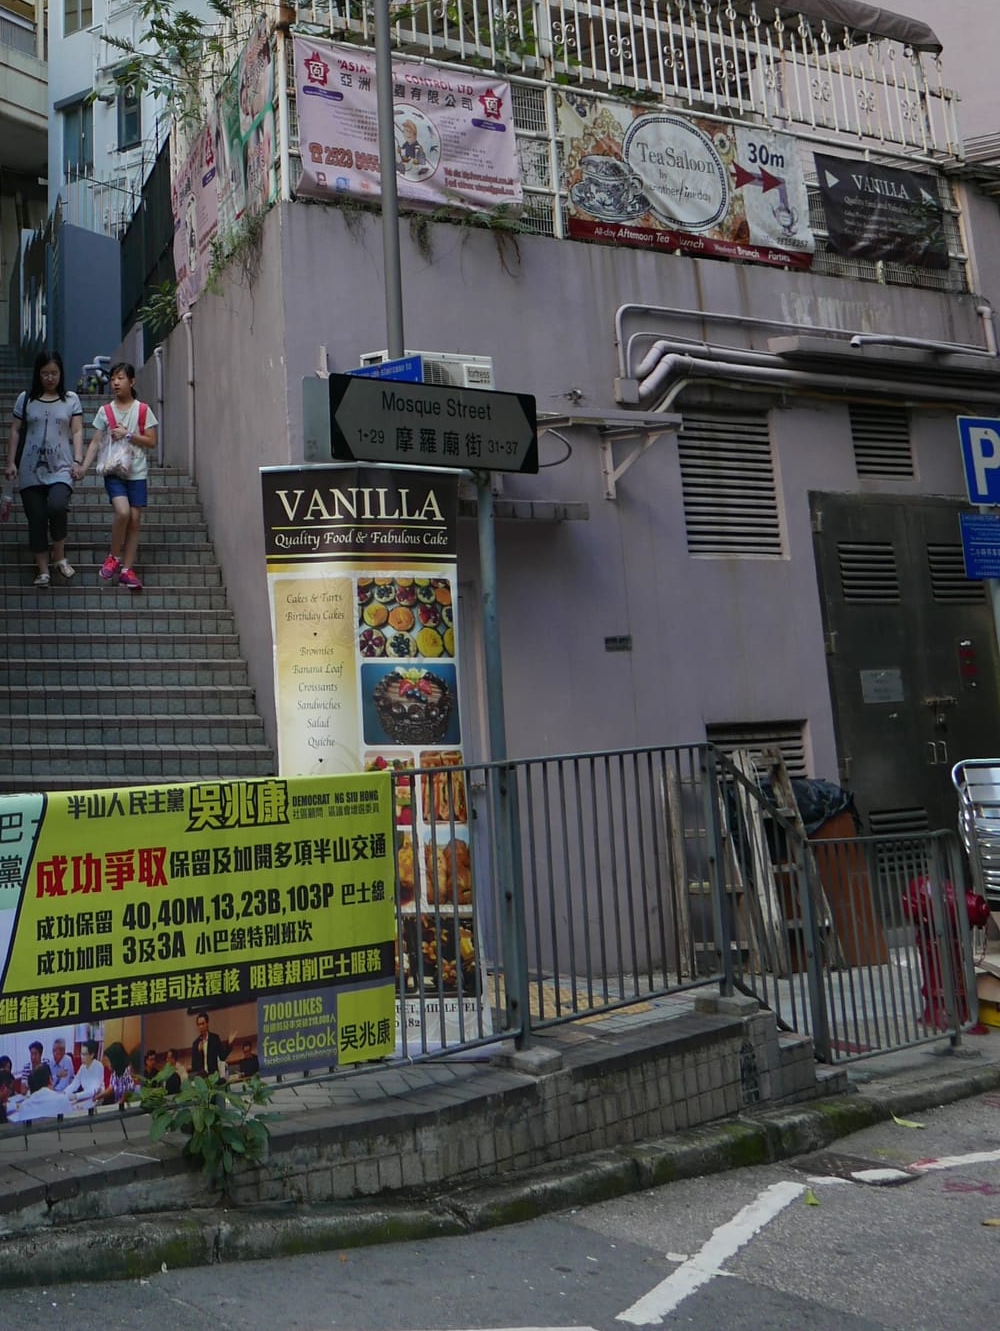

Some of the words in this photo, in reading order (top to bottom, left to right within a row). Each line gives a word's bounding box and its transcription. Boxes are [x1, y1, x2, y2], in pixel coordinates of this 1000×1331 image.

[339, 72, 474, 112] 亞洲蟲有限公司
[405, 74, 453, 92] CONTROL
[747, 142, 785, 168] 30m
[851, 174, 911, 200] VANILLA
[617, 227, 654, 243] Afternoon
[656, 232, 670, 244] Tea
[736, 245, 760, 260] Brunch
[768, 249, 791, 263] Parties
[381, 390, 441, 418] Mosque
[446, 397, 493, 421] Street
[395, 426, 482, 459] 摩羅廟街
[968, 426, 1000, 496] P
[275, 487, 446, 522] VANILLA
[274, 531, 321, 551] Quality
[323, 528, 354, 545] Food
[355, 531, 369, 545] &
[370, 529, 421, 545] Fabulous
[422, 531, 449, 546] Cake
[286, 593, 309, 604] Cakes
[311, 593, 321, 604] &
[320, 593, 343, 603] Tarts
[285, 611, 322, 623] Birthday
[322, 610, 345, 621] Cakes
[299, 646, 335, 657] Brownies
[291, 664, 323, 675] Banana
[324, 662, 345, 678] Loaf
[298, 682, 338, 693] Croissants
[296, 700, 342, 711] Sandwiches
[306, 718, 330, 729] Salad
[307, 737, 336, 749] Quiche
[67, 787, 185, 821] 半山人民主黨
[186, 780, 290, 832] 吳兆康
[292, 793, 331, 807] DEMOCRAT
[334, 792, 345, 804] NG
[346, 791, 358, 803] SIU
[359, 789, 379, 802] HONG
[36, 846, 169, 899] 成功爭取
[169, 833, 387, 879] 保留及加開多項半山交通
[36, 909, 113, 941] 成功保留
[122, 882, 335, 931] 40,40M,13,23B,103P
[341, 880, 385, 906] 巴士線
[36, 943, 113, 976] 成功加開
[122, 931, 186, 965] 3及3A
[196, 920, 314, 956] 小巴線特別班次
[90, 967, 241, 1013] 民主黨提司法覆核
[249, 945, 382, 991] 阻違規削巴士服務
[262, 1000, 293, 1023] 7000
[293, 996, 323, 1018] LIKES
[262, 1027, 337, 1057] facebook
[340, 1018, 391, 1052] 吳兆康
